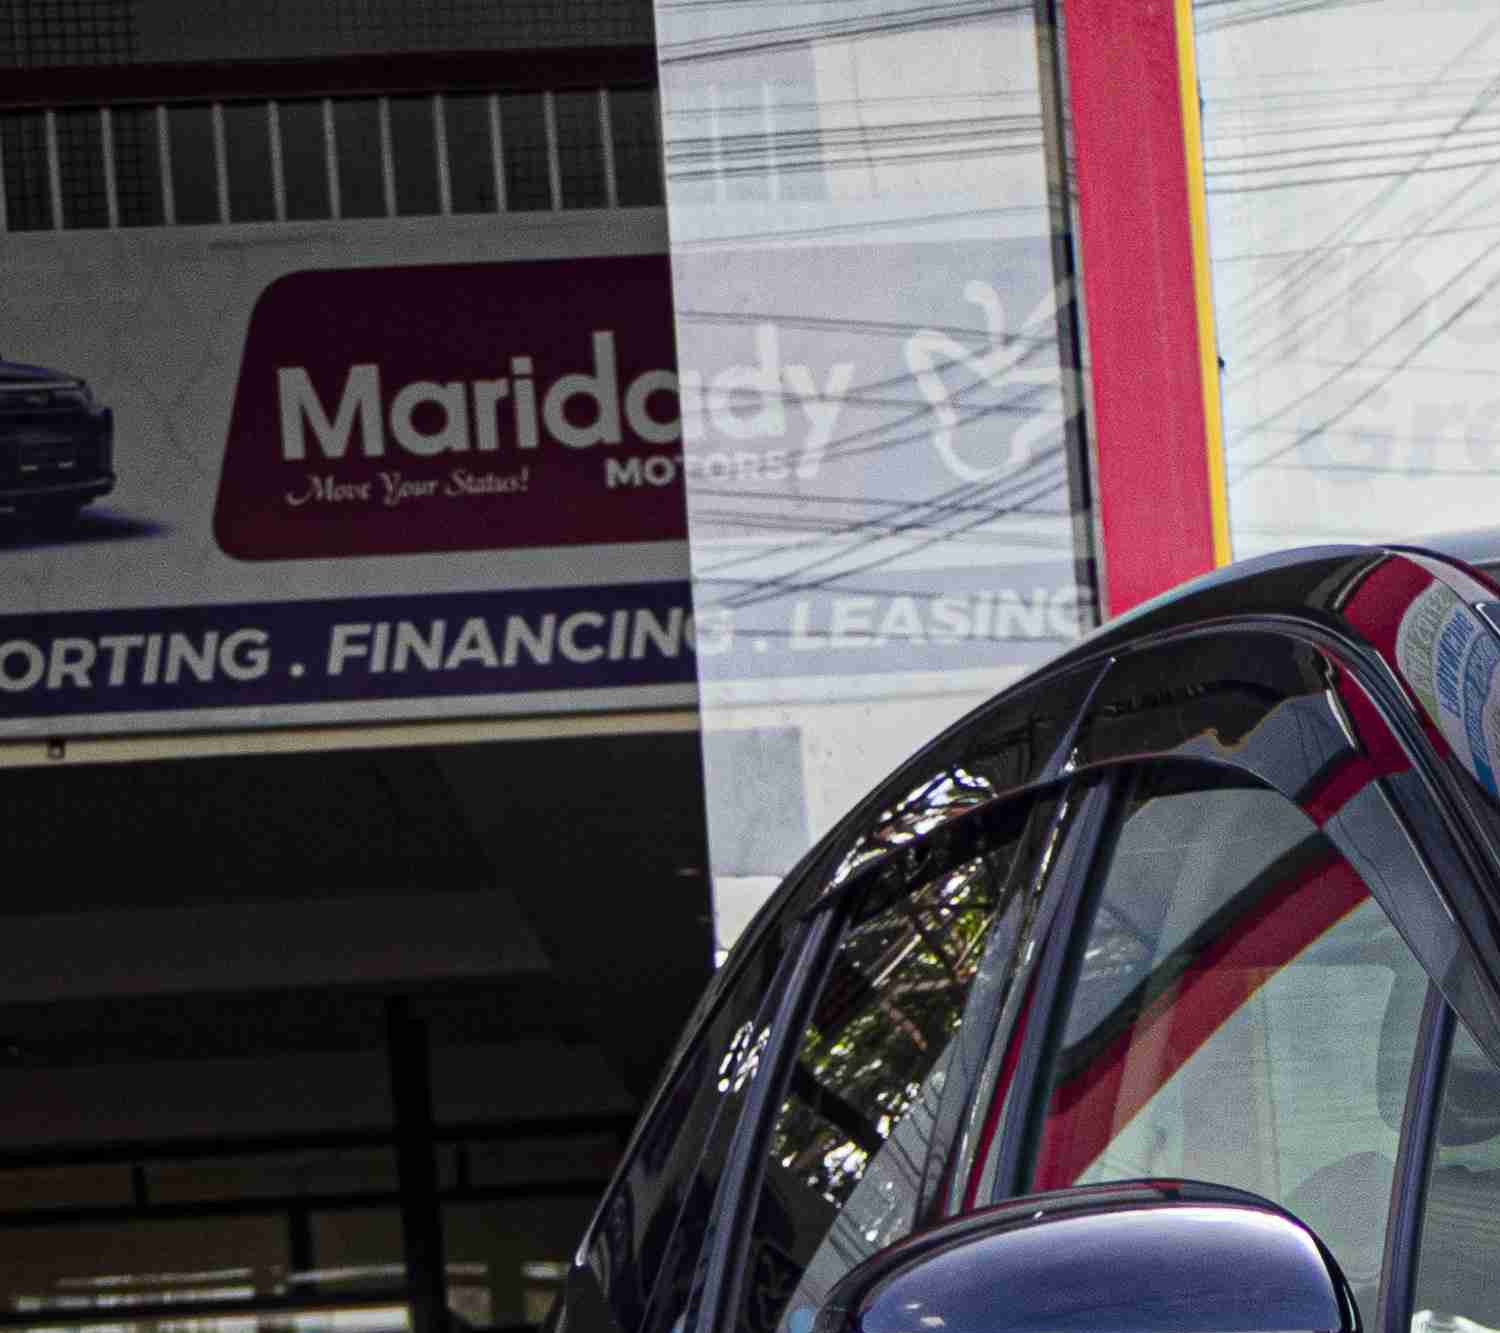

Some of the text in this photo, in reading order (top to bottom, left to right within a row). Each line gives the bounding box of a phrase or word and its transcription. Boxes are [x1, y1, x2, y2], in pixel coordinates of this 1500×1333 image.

[276, 322, 856, 479] Maridady
[286, 466, 530, 506] Move Your Status!
[606, 450, 788, 488] MOTORS
[0, 585, 1093, 692] ORTING FINANCING LEASING
